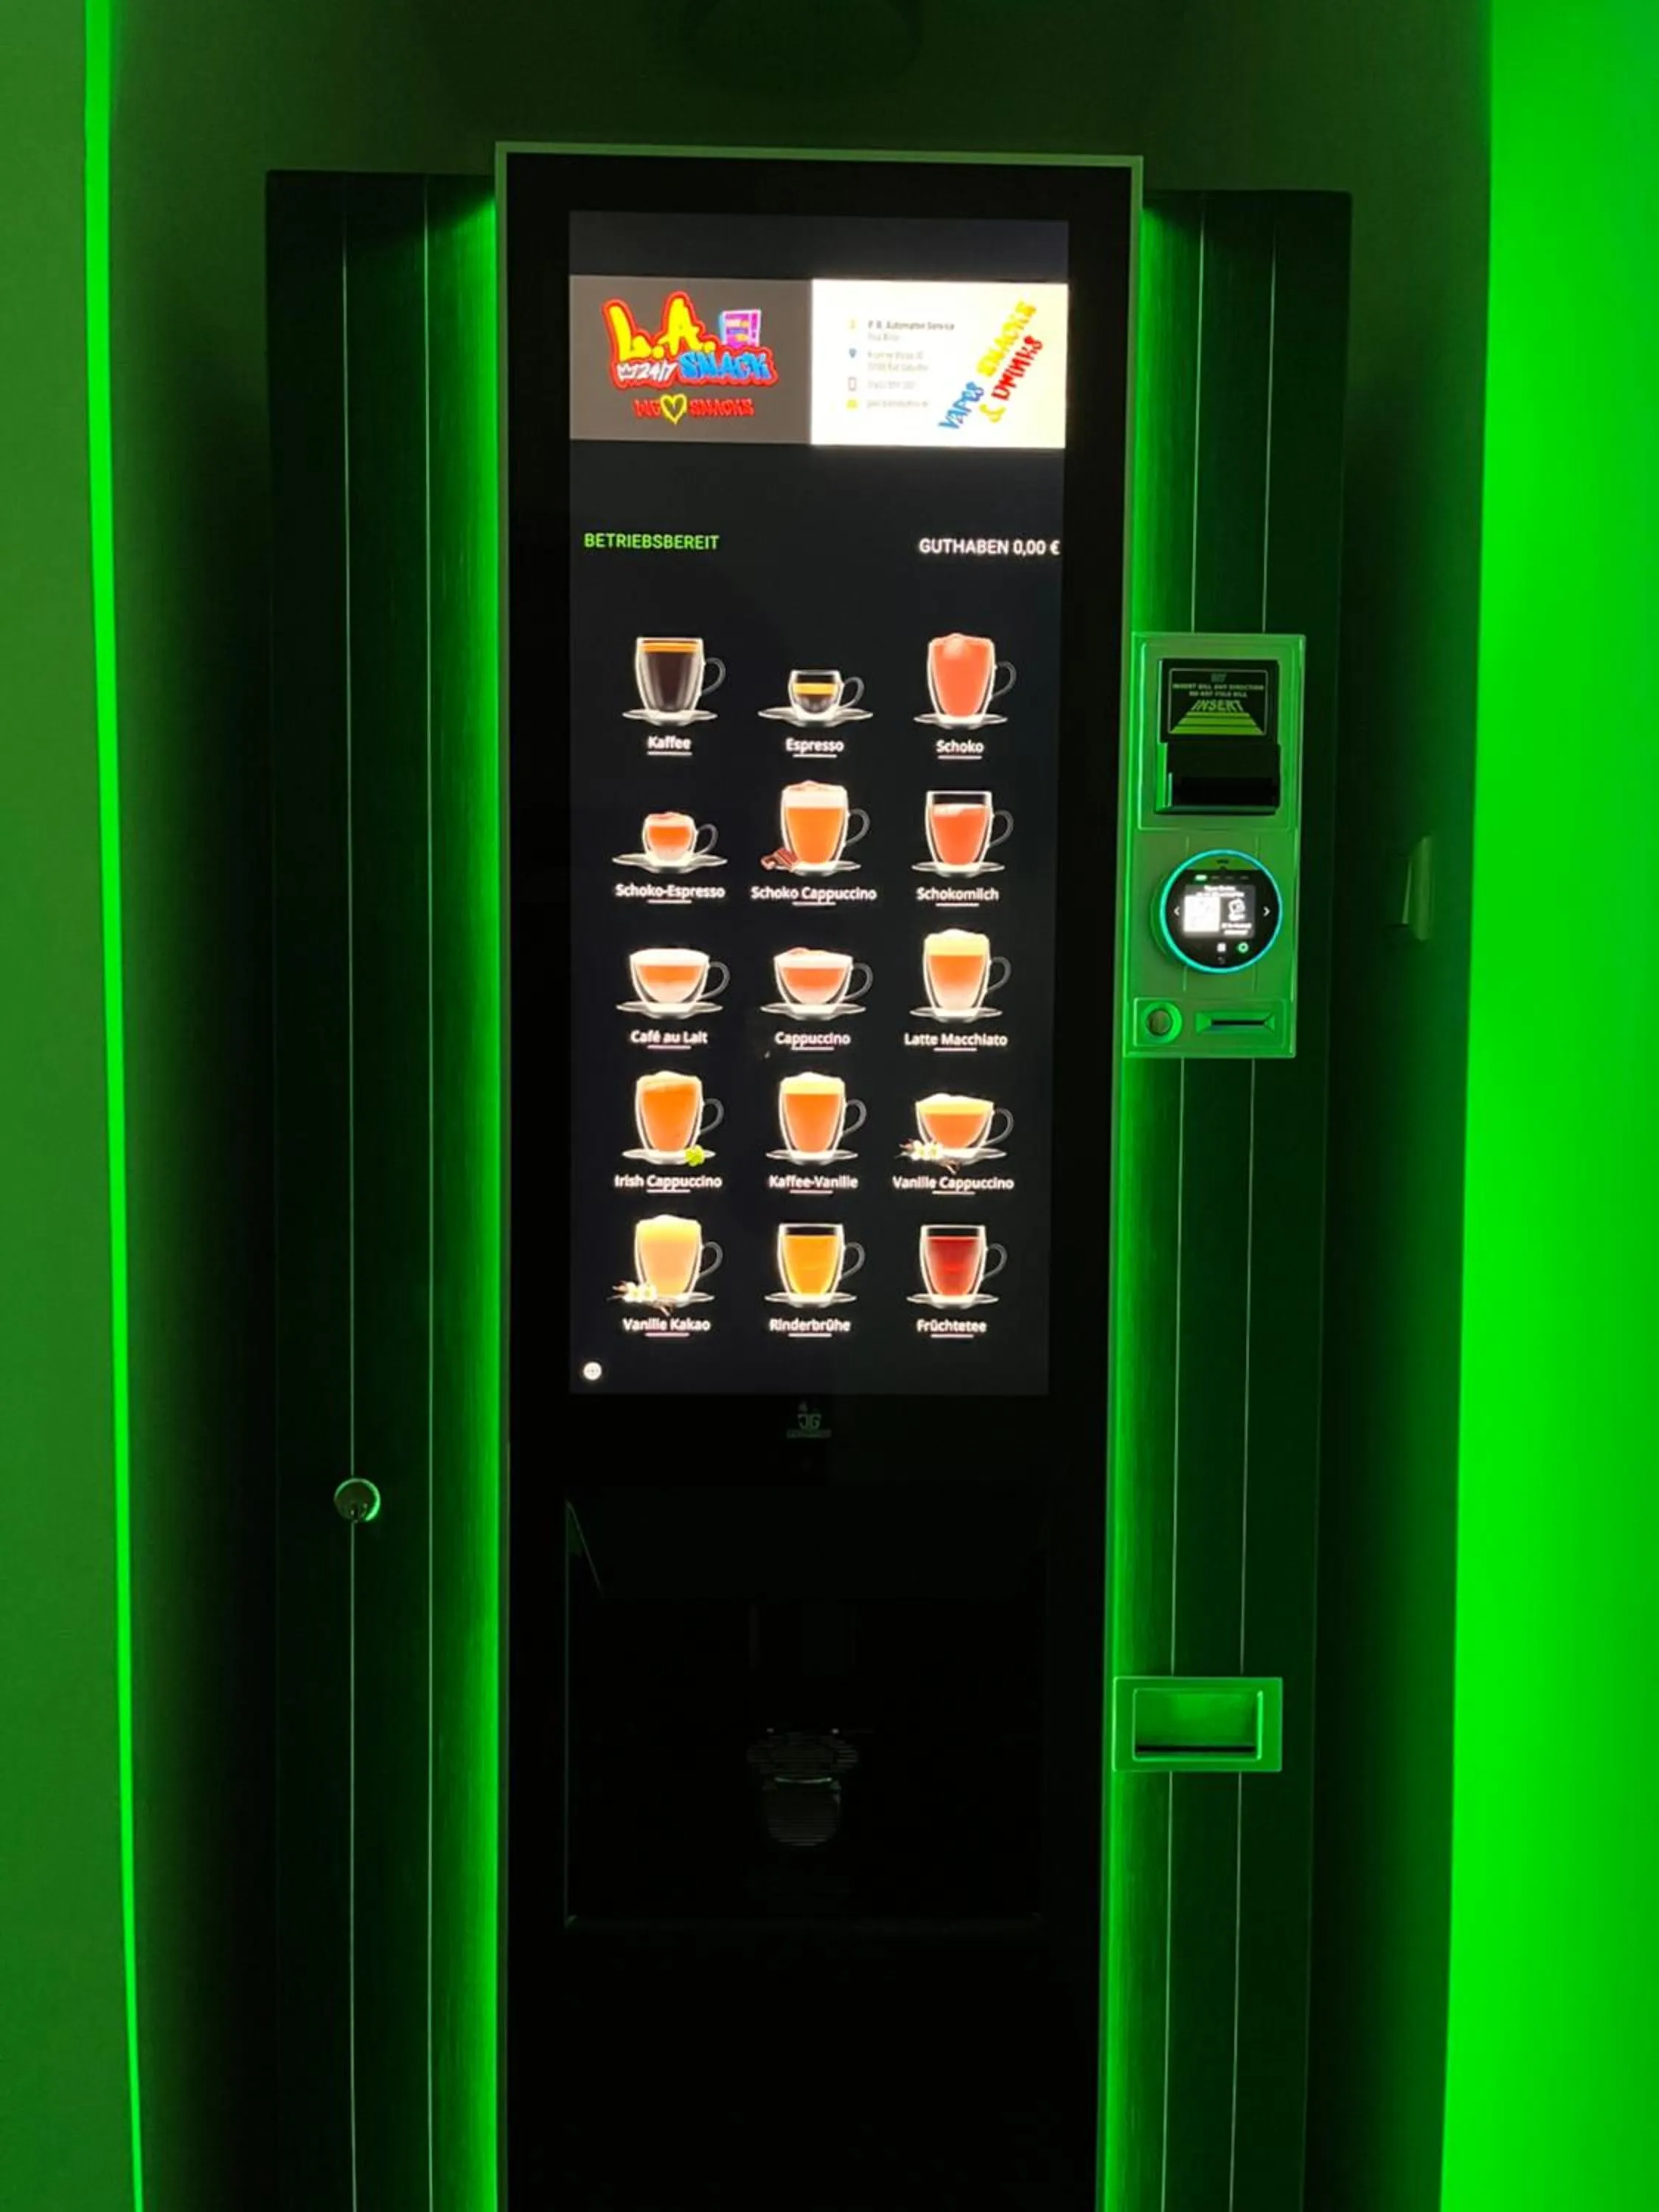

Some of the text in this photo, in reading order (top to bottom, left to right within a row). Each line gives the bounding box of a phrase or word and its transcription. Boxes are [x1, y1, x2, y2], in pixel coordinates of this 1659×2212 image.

[603, 293, 719, 362] L.A.
[584, 532, 720, 550] BETRIEBSBEREIT
[919, 538, 1060, 557] GUTHABEN 0,00 €
[1191, 699, 1244, 712] INSERT
[647, 735, 692, 750] Kaffee
[785, 737, 844, 754] Espresso
[936, 739, 984, 754] Schoko
[615, 883, 726, 900] Schoko-Espresso
[751, 886, 877, 903] Schoko Cappuccino
[916, 887, 999, 901] Schokomilch
[630, 1029, 708, 1044] Café au Lait
[774, 1031, 851, 1048] Cappuccino
[904, 1032, 1008, 1046] Latte Macchiato
[614, 1174, 723, 1191] Irish Cappuccino
[768, 1175, 858, 1189] Kaffee-Vanille
[893, 1176, 1015, 1192] Vanille Cappuccino
[622, 1318, 711, 1332] Vanille Kakao
[768, 1318, 851, 1332] Rinderbrühe
[916, 1318, 987, 1333] Früchtetee
